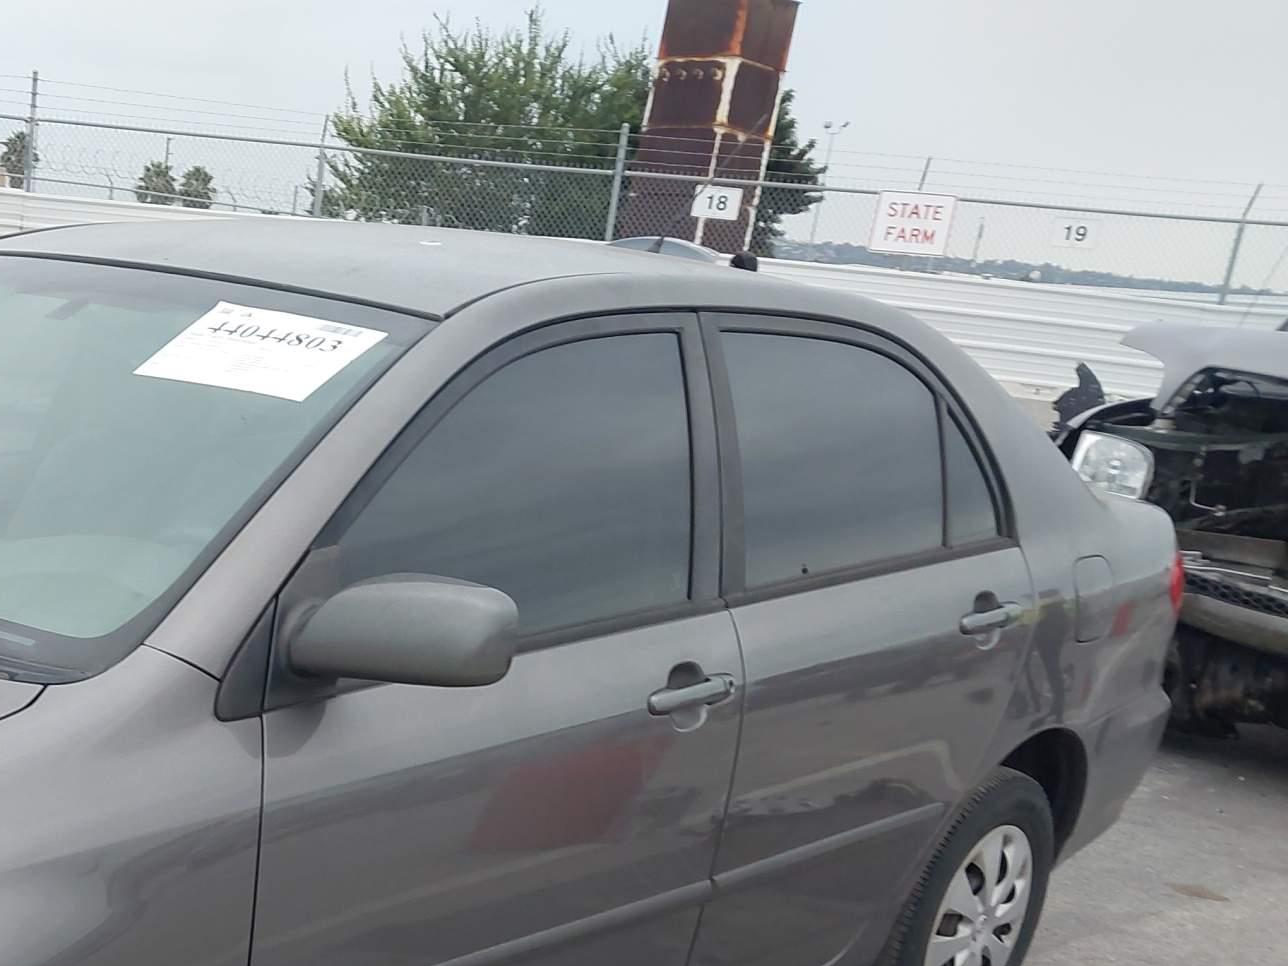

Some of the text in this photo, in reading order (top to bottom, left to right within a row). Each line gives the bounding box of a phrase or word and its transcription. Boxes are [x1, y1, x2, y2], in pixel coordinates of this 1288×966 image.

[706, 194, 728, 211] 18
[887, 201, 944, 221] STATE
[883, 225, 936, 245] FARM
[1064, 225, 1088, 242] 19
[208, 321, 343, 352] 44044803
